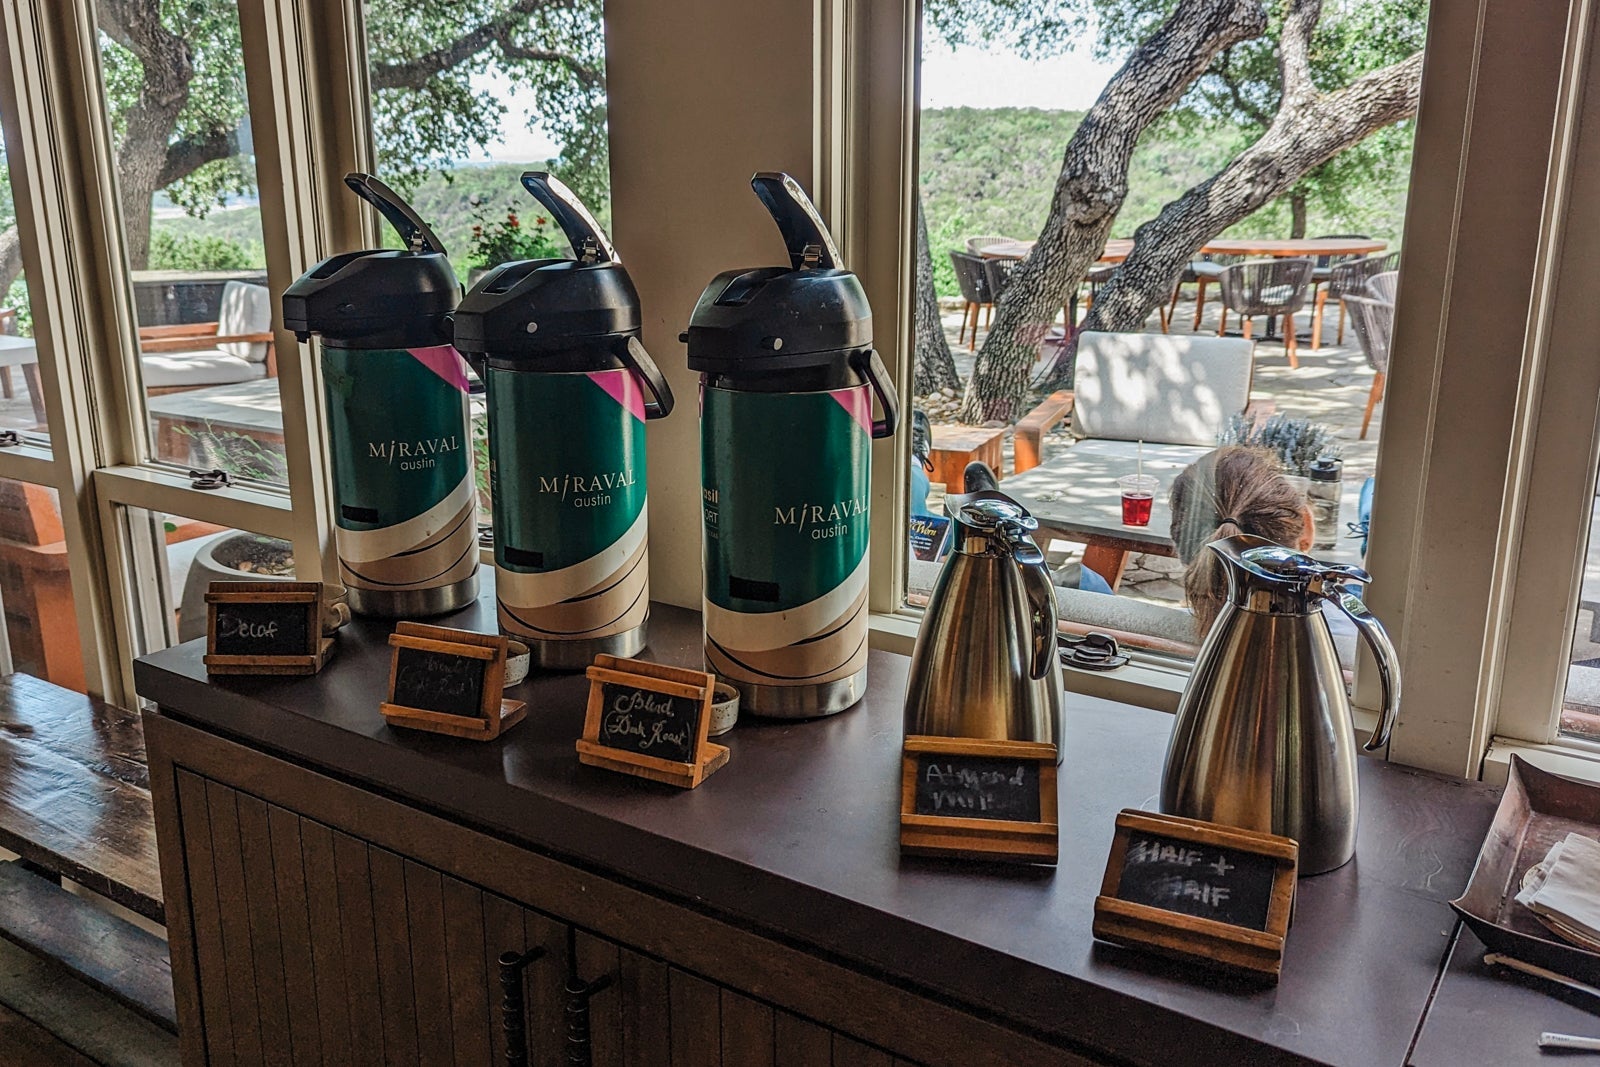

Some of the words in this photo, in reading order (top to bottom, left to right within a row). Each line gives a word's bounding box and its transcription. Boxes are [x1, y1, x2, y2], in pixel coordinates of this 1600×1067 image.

[400, 457, 436, 471] austin
[574, 493, 612, 508] austin
[811, 522, 848, 540] austin
